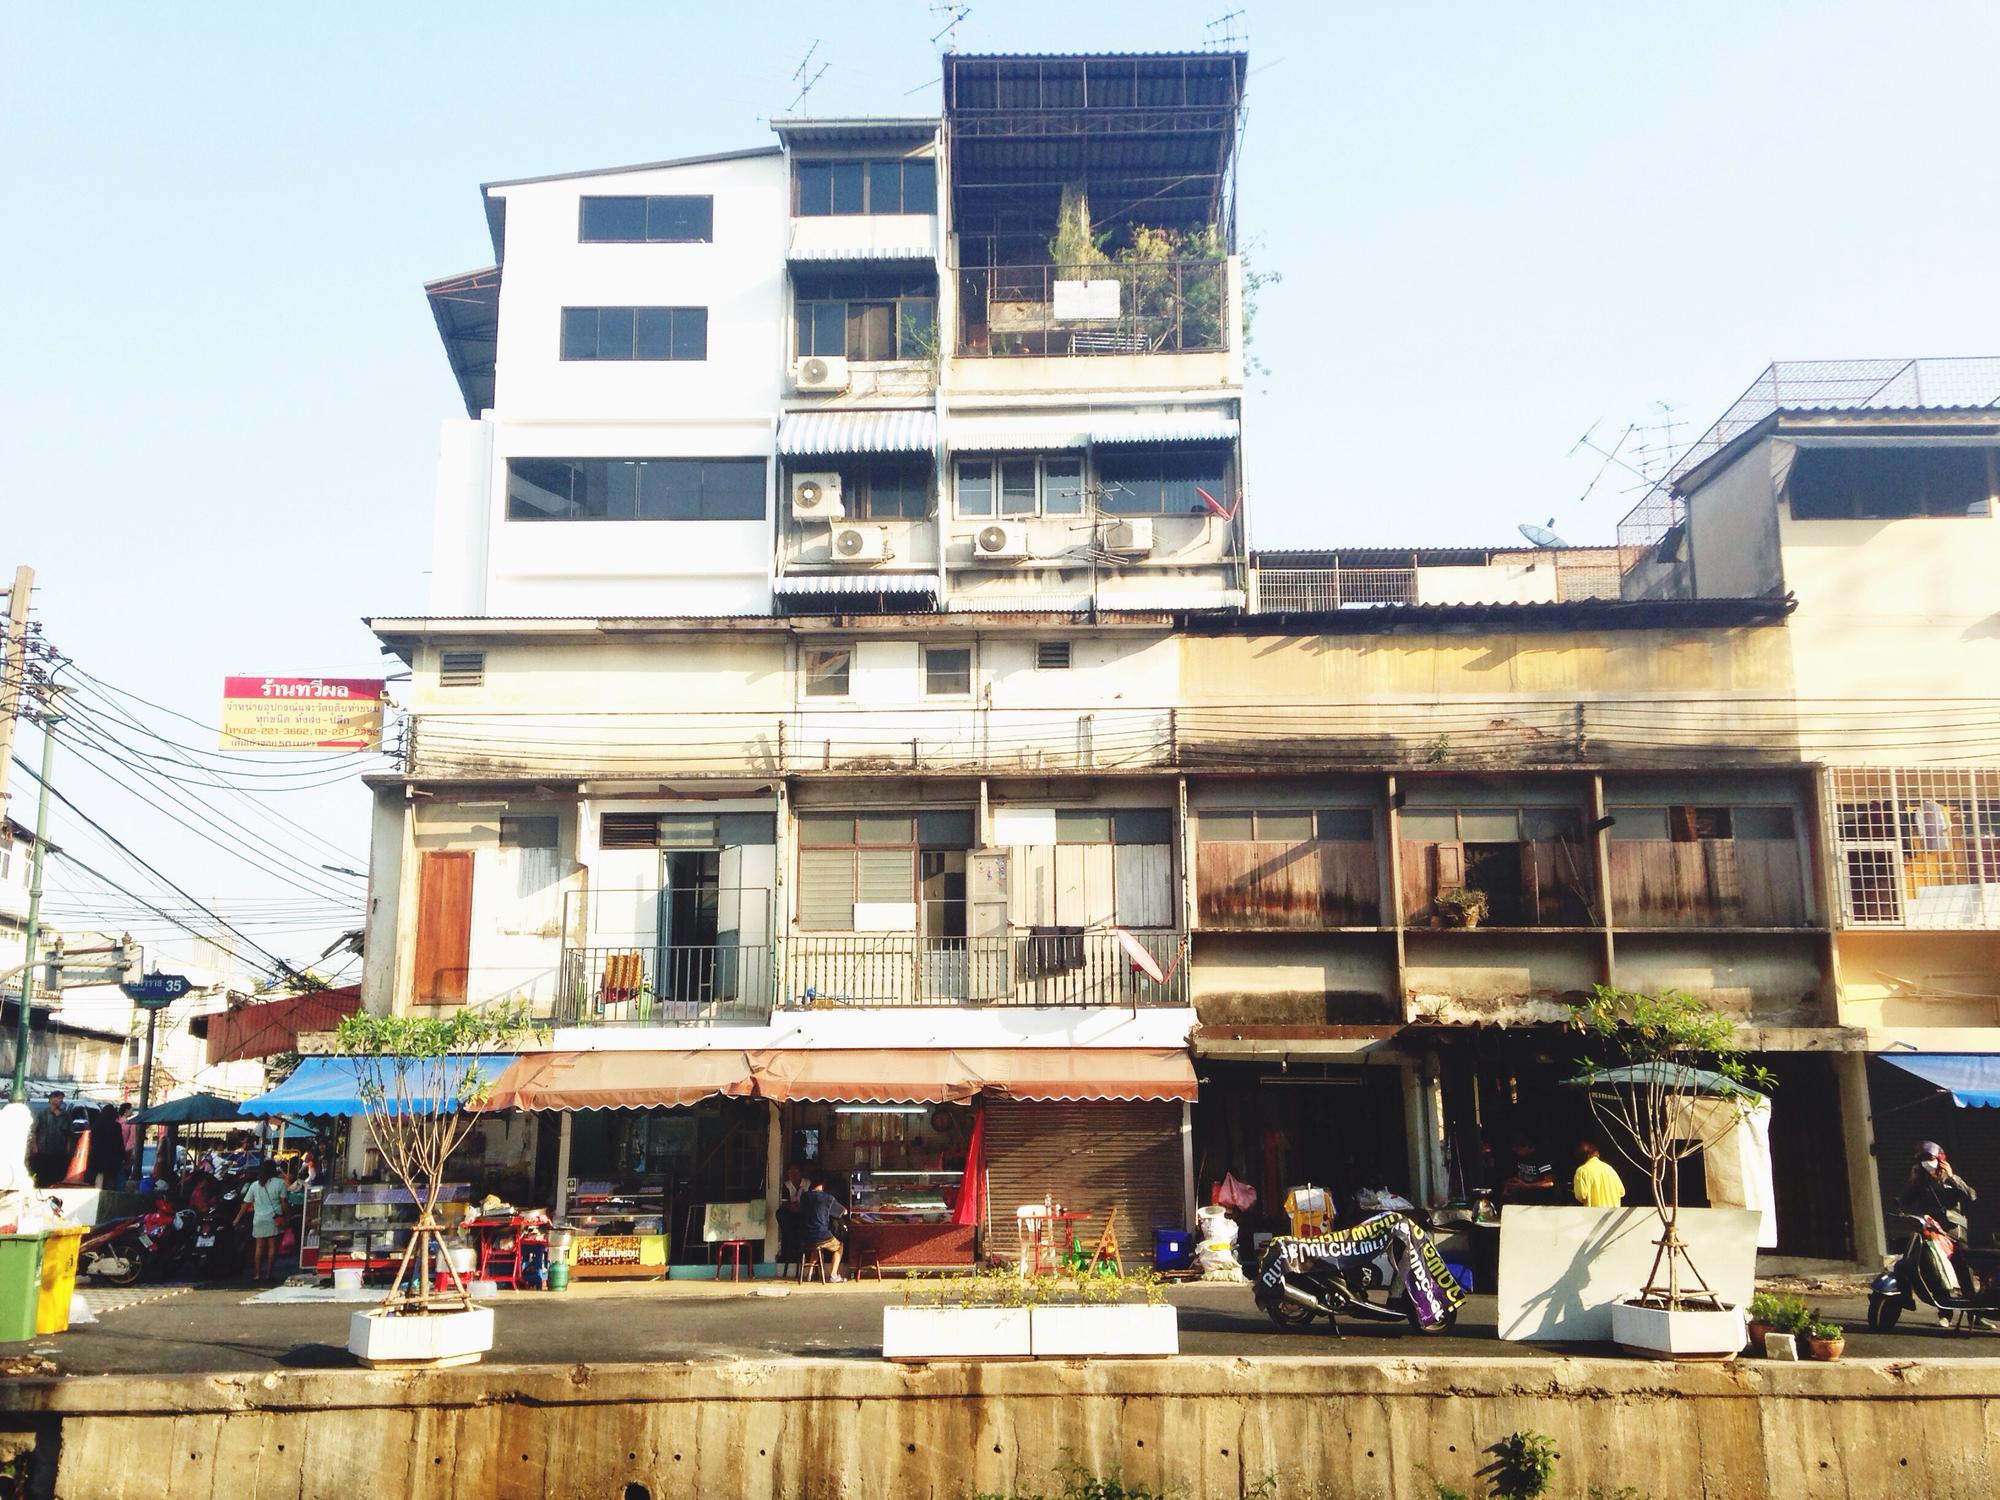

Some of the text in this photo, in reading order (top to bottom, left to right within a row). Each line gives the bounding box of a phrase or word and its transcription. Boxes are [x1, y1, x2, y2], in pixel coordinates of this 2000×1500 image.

[260, 679, 349, 697] ร้านทวีผล
[165, 980, 182, 992] 35
